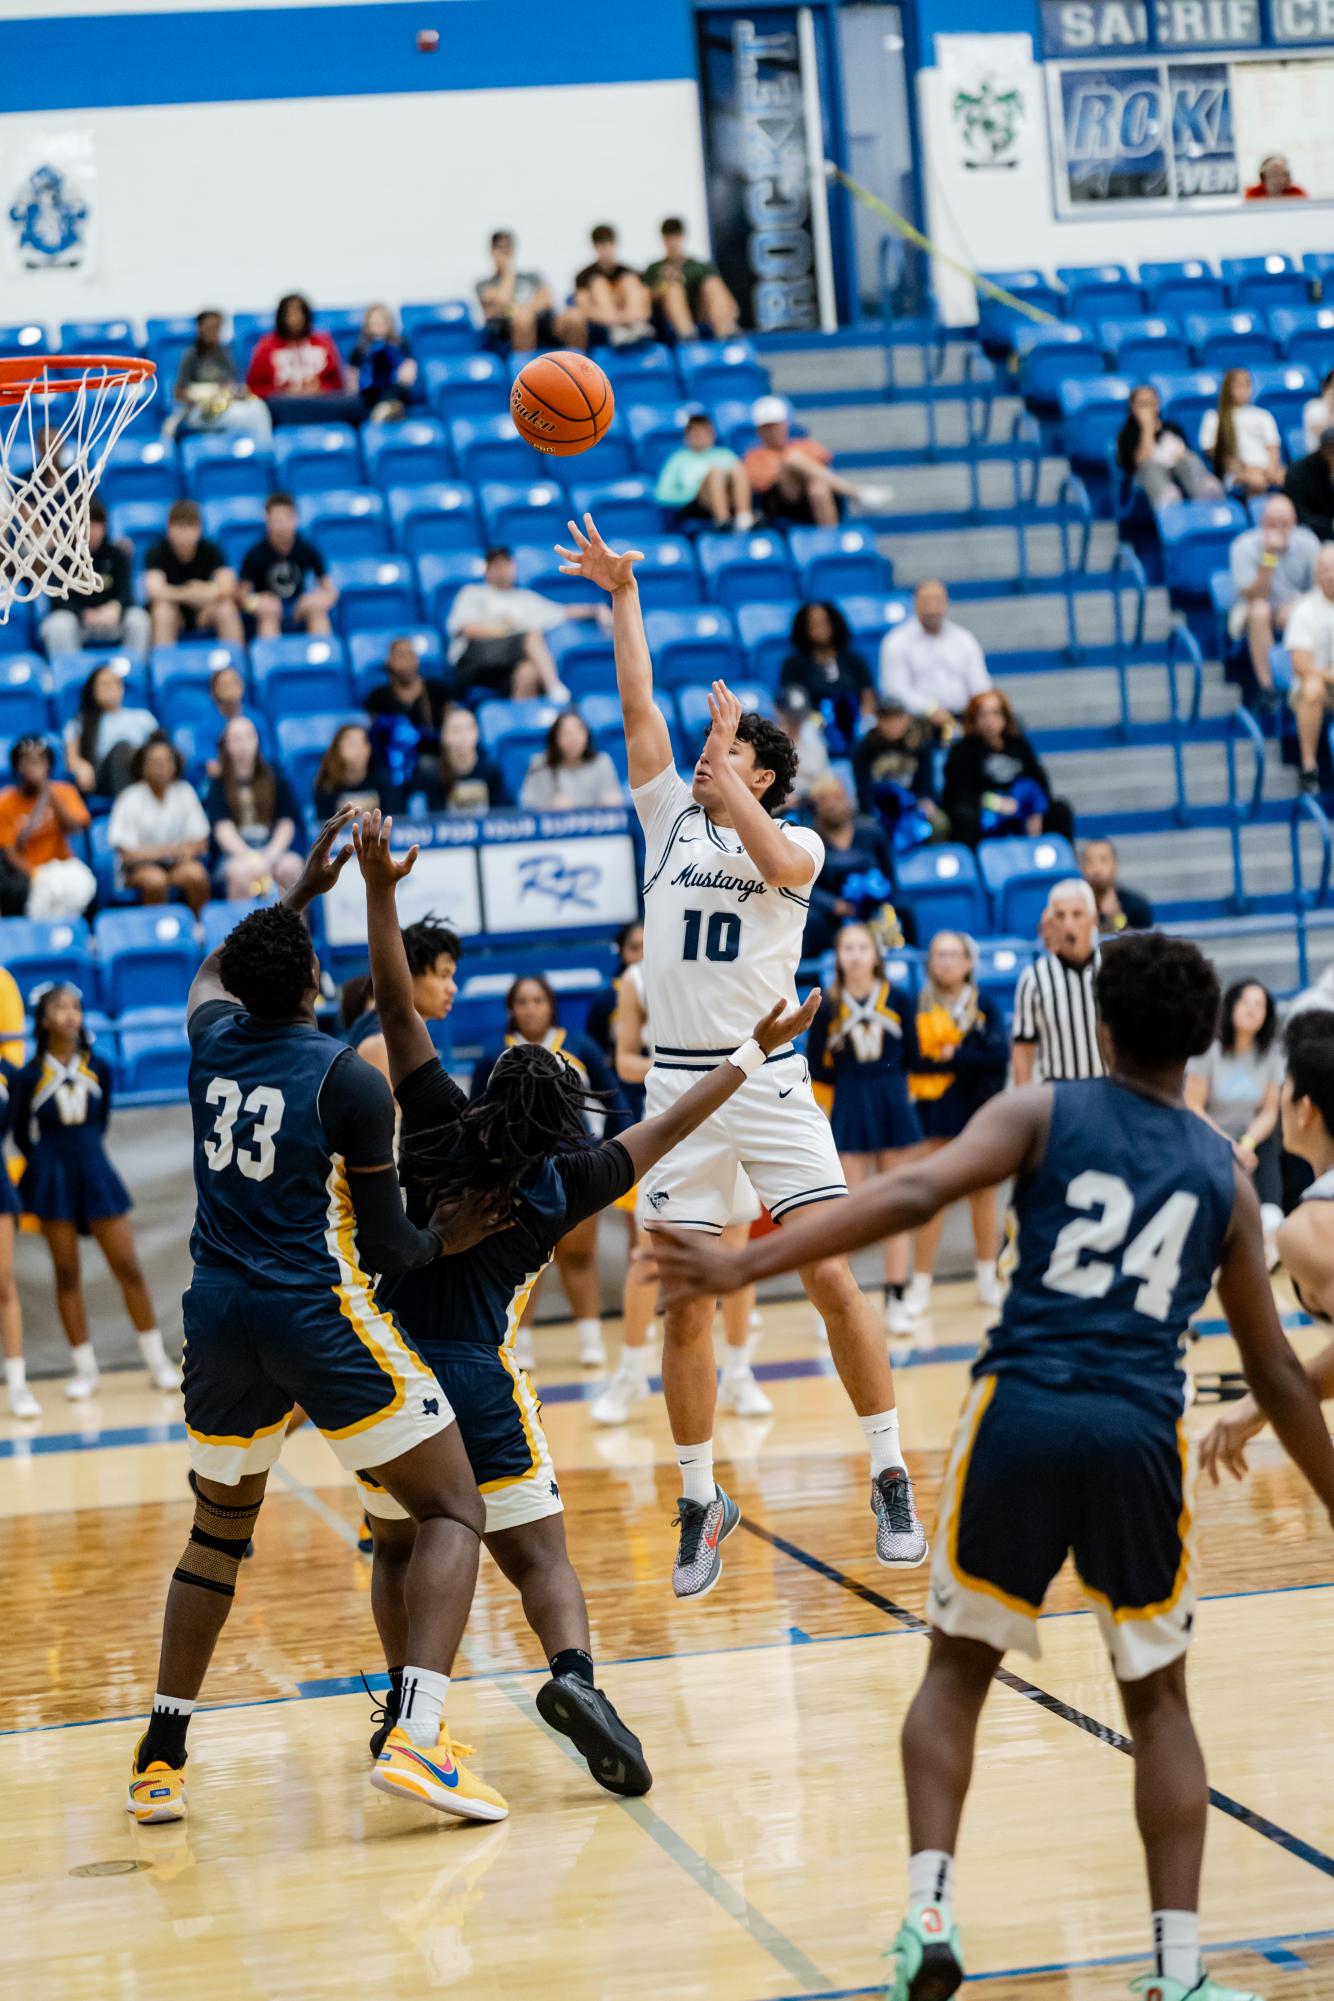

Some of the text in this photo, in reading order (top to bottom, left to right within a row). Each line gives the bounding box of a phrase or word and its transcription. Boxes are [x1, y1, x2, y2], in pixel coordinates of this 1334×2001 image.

[671, 862, 767, 902] Mustangs
[682, 908, 742, 963] 10
[204, 1077, 285, 1182] 33
[1042, 1169, 1199, 1322] 24
